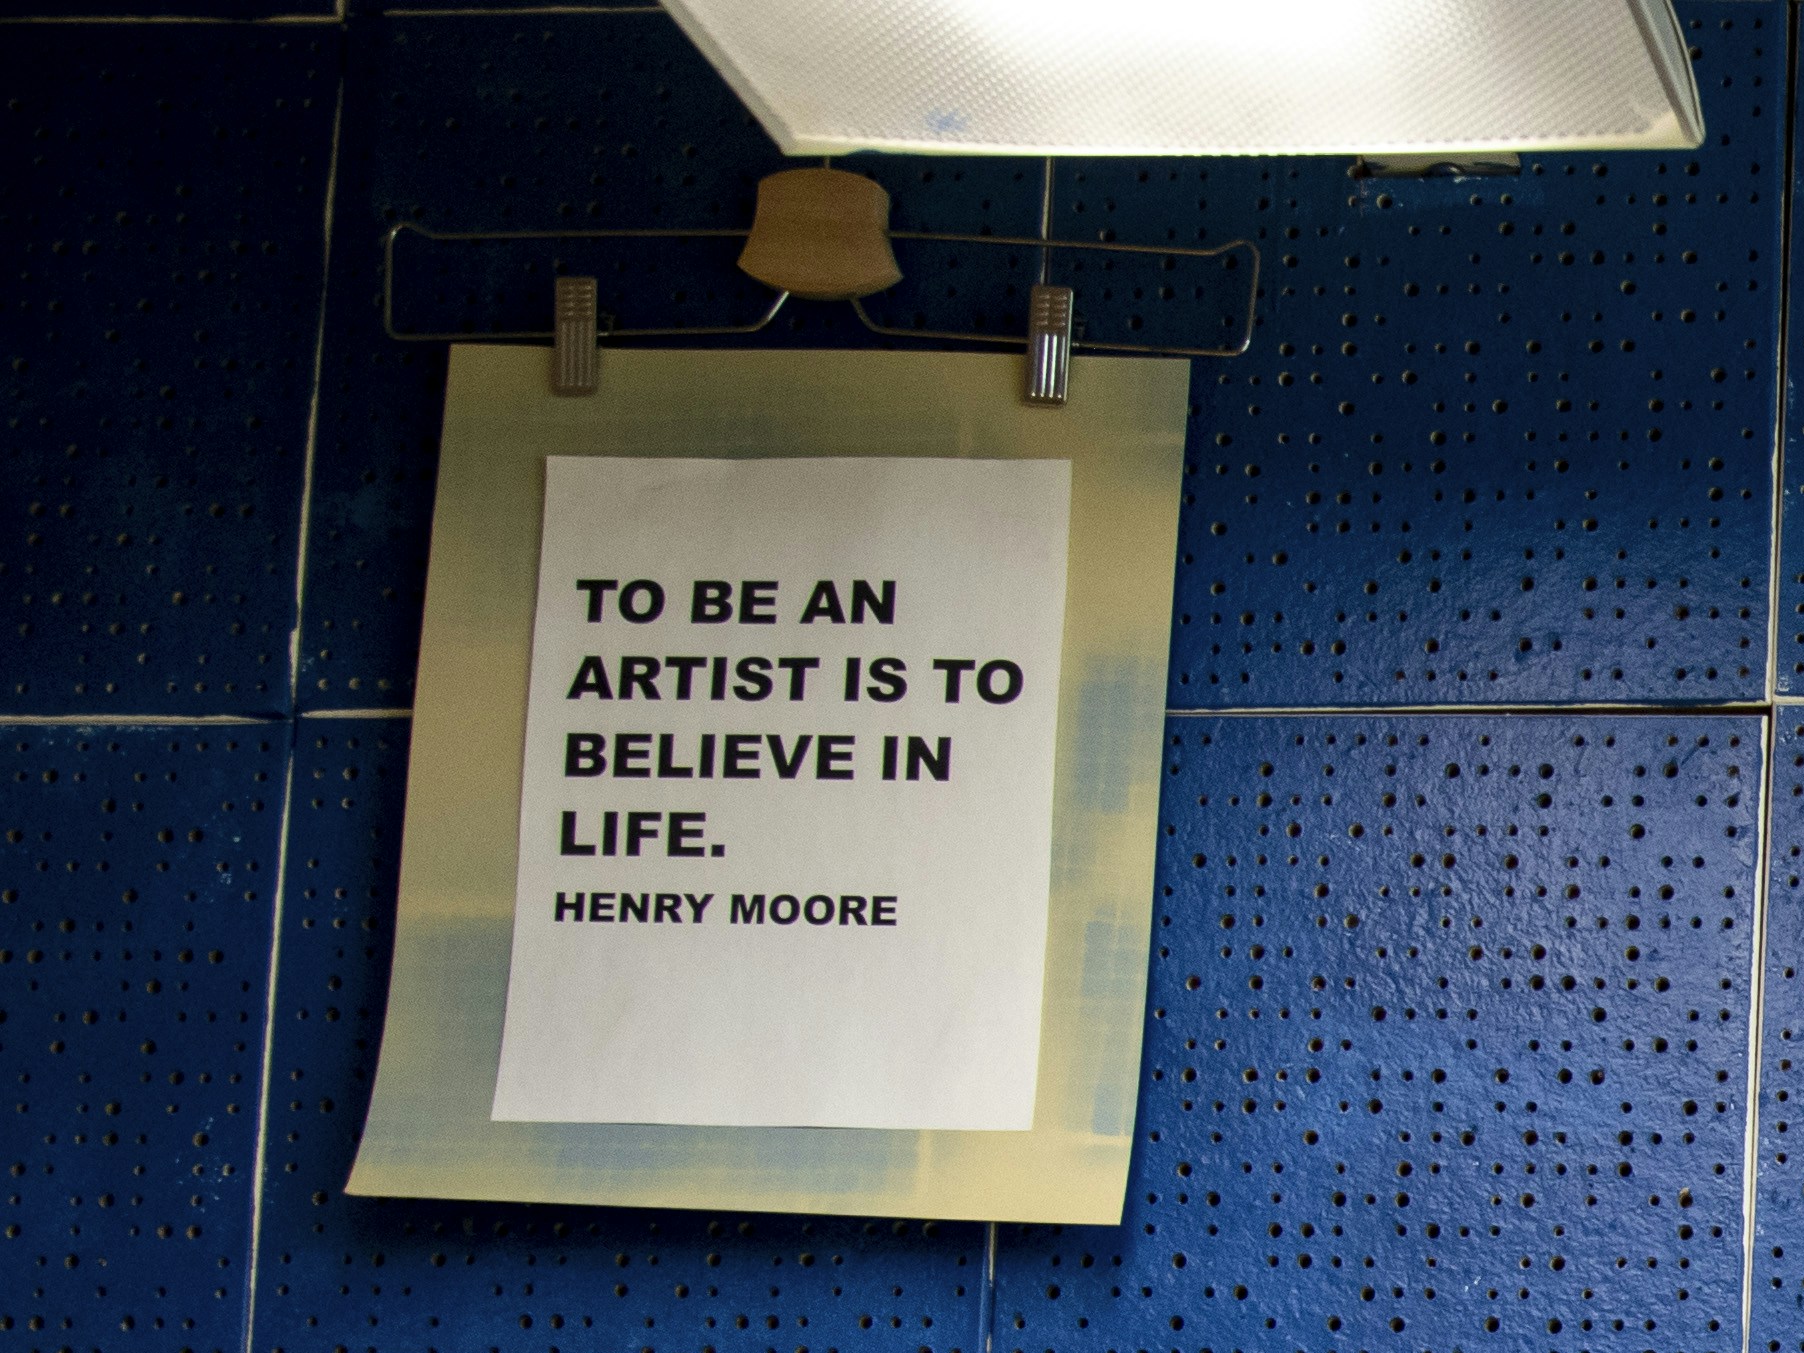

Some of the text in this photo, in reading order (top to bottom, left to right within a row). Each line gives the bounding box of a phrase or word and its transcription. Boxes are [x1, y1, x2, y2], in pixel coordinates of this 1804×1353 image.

[576, 579, 896, 624] TO BE AN
[566, 656, 1023, 704] ARTIST IS TO
[565, 733, 951, 781] BELIEVE IN
[561, 811, 725, 857] LIFE.
[555, 892, 897, 926] HENRY MOORE
